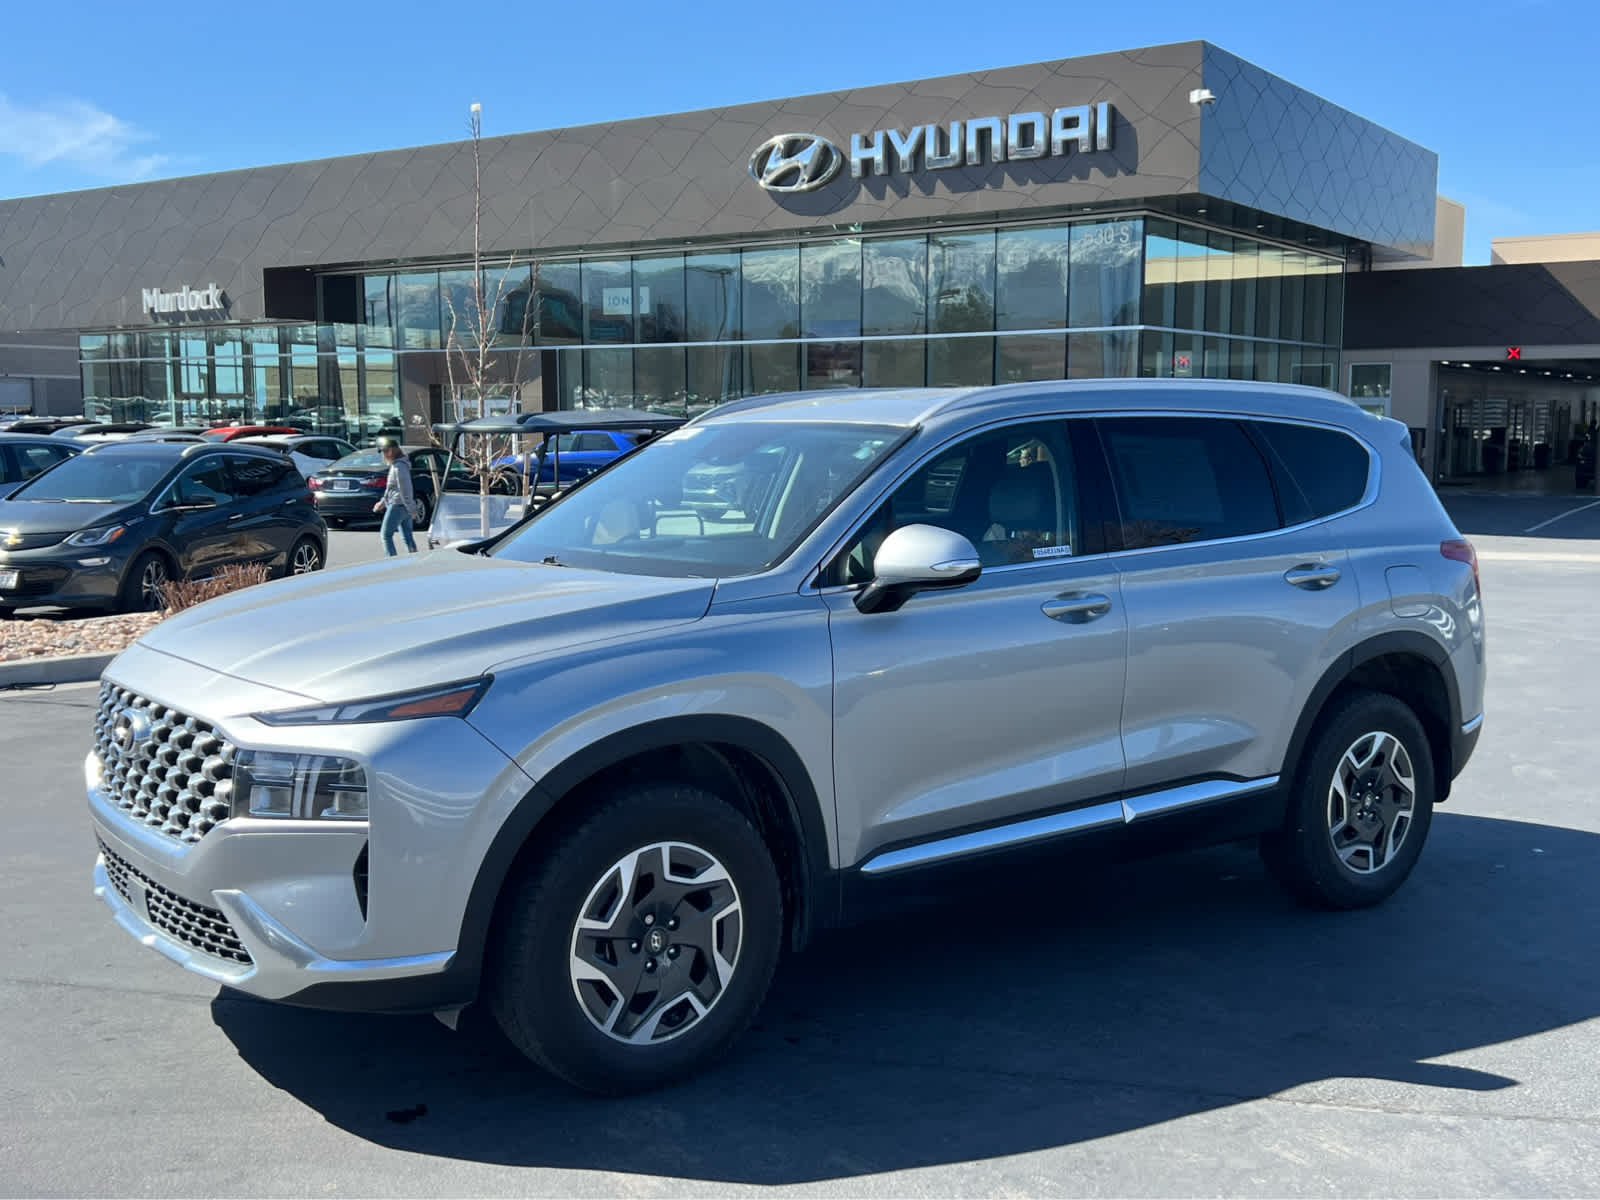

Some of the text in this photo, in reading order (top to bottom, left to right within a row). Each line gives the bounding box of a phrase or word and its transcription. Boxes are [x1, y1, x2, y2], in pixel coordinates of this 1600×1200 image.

[850, 101, 1113, 178] HYUNDAI
[142, 282, 224, 313] Murdock
[607, 295, 645, 306] ION
